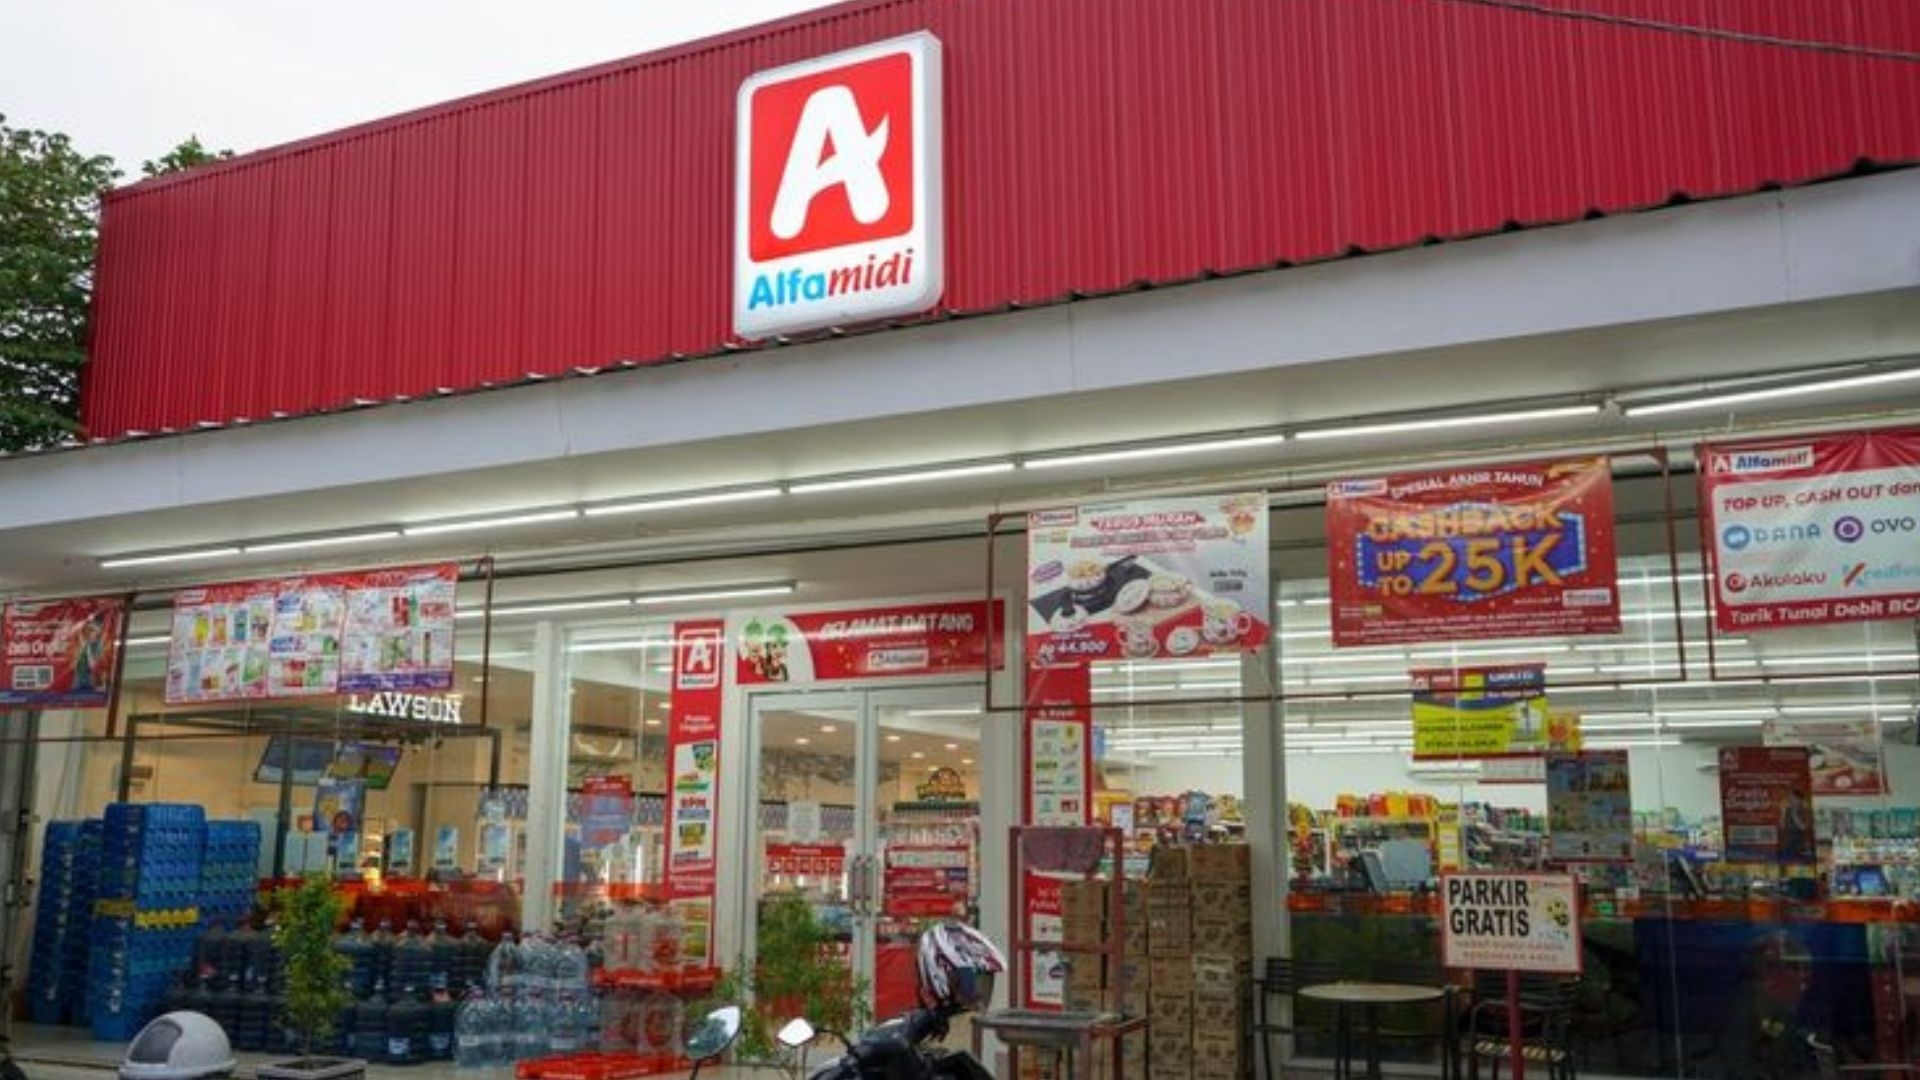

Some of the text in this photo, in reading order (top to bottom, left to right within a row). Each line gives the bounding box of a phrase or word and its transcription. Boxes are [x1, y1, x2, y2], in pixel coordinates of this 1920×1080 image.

[769, 85, 890, 240] A
[748, 248, 914, 310] Alfamidi
[1735, 451, 1809, 470] Alfamidi
[1494, 470, 1544, 488] TAHUN
[1723, 497, 1757, 512] TOP
[1795, 489, 1842, 506] CASH
[1846, 484, 1884, 499] OUT
[1367, 502, 1563, 541] CASHBACK
[1754, 515, 1916, 543] DANA OVO
[1376, 551, 1412, 572] UP
[1377, 575, 1413, 597] TO
[1750, 571, 1827, 589] Akulaku
[1730, 609, 1774, 625] Tarik
[1779, 604, 1828, 621] Tunai
[1834, 599, 1884, 617] Debit
[347, 691, 463, 724] LAWSON
[1448, 879, 1530, 907] PARKIR
[1450, 908, 1530, 937] GRATIS
